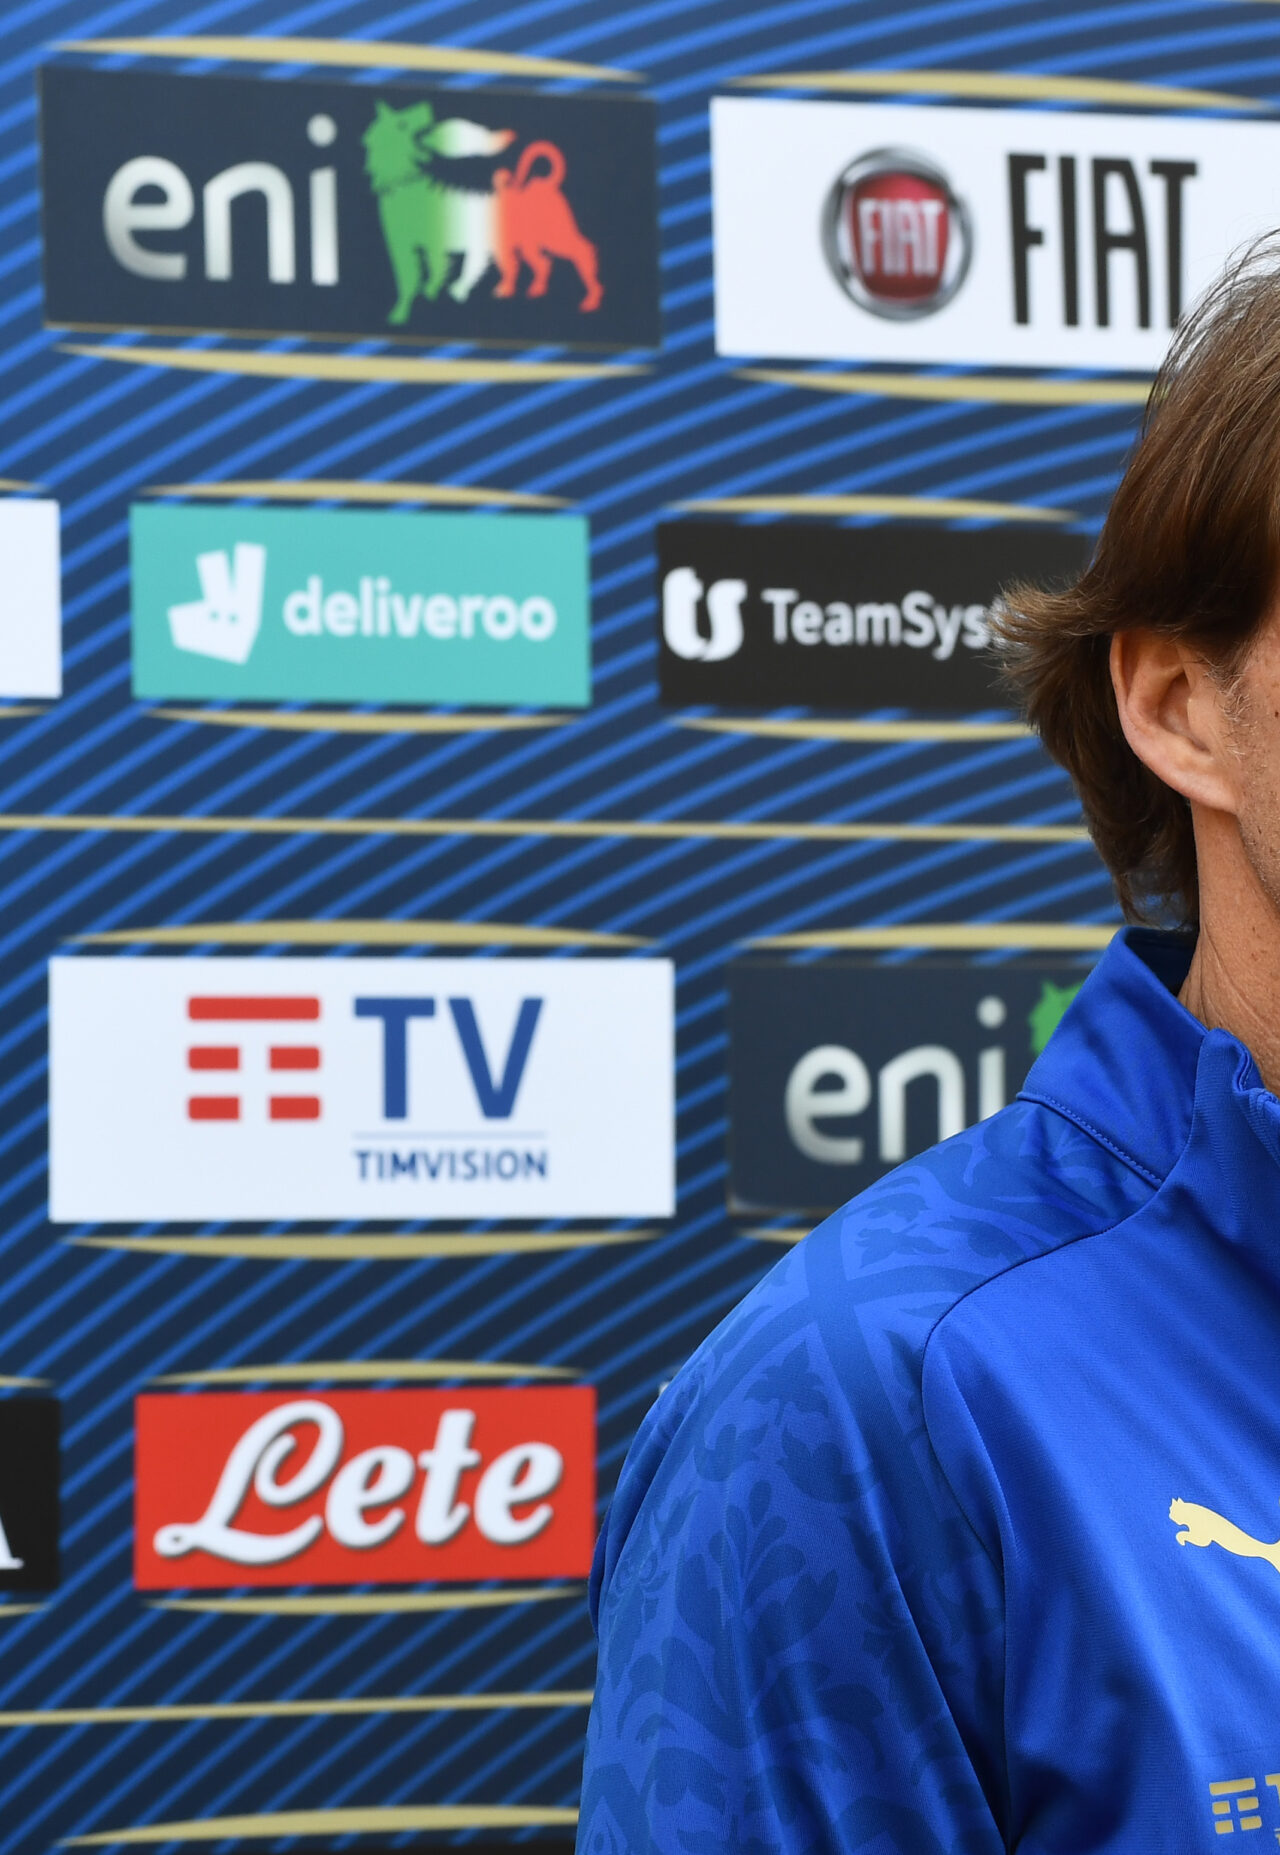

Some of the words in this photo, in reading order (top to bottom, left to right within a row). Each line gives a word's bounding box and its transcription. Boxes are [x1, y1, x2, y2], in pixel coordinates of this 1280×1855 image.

[103, 114, 339, 286] eni
[858, 198, 945, 277] FIAT
[1007, 153, 1198, 329] FIAT
[284, 575, 558, 642] deliveroo
[761, 589, 1008, 661] TeamSys
[353, 996, 544, 1121] TV
[785, 996, 1007, 1166] eni
[353, 1149, 549, 1182] TIMVISION
[153, 1399, 564, 1566] Lete
